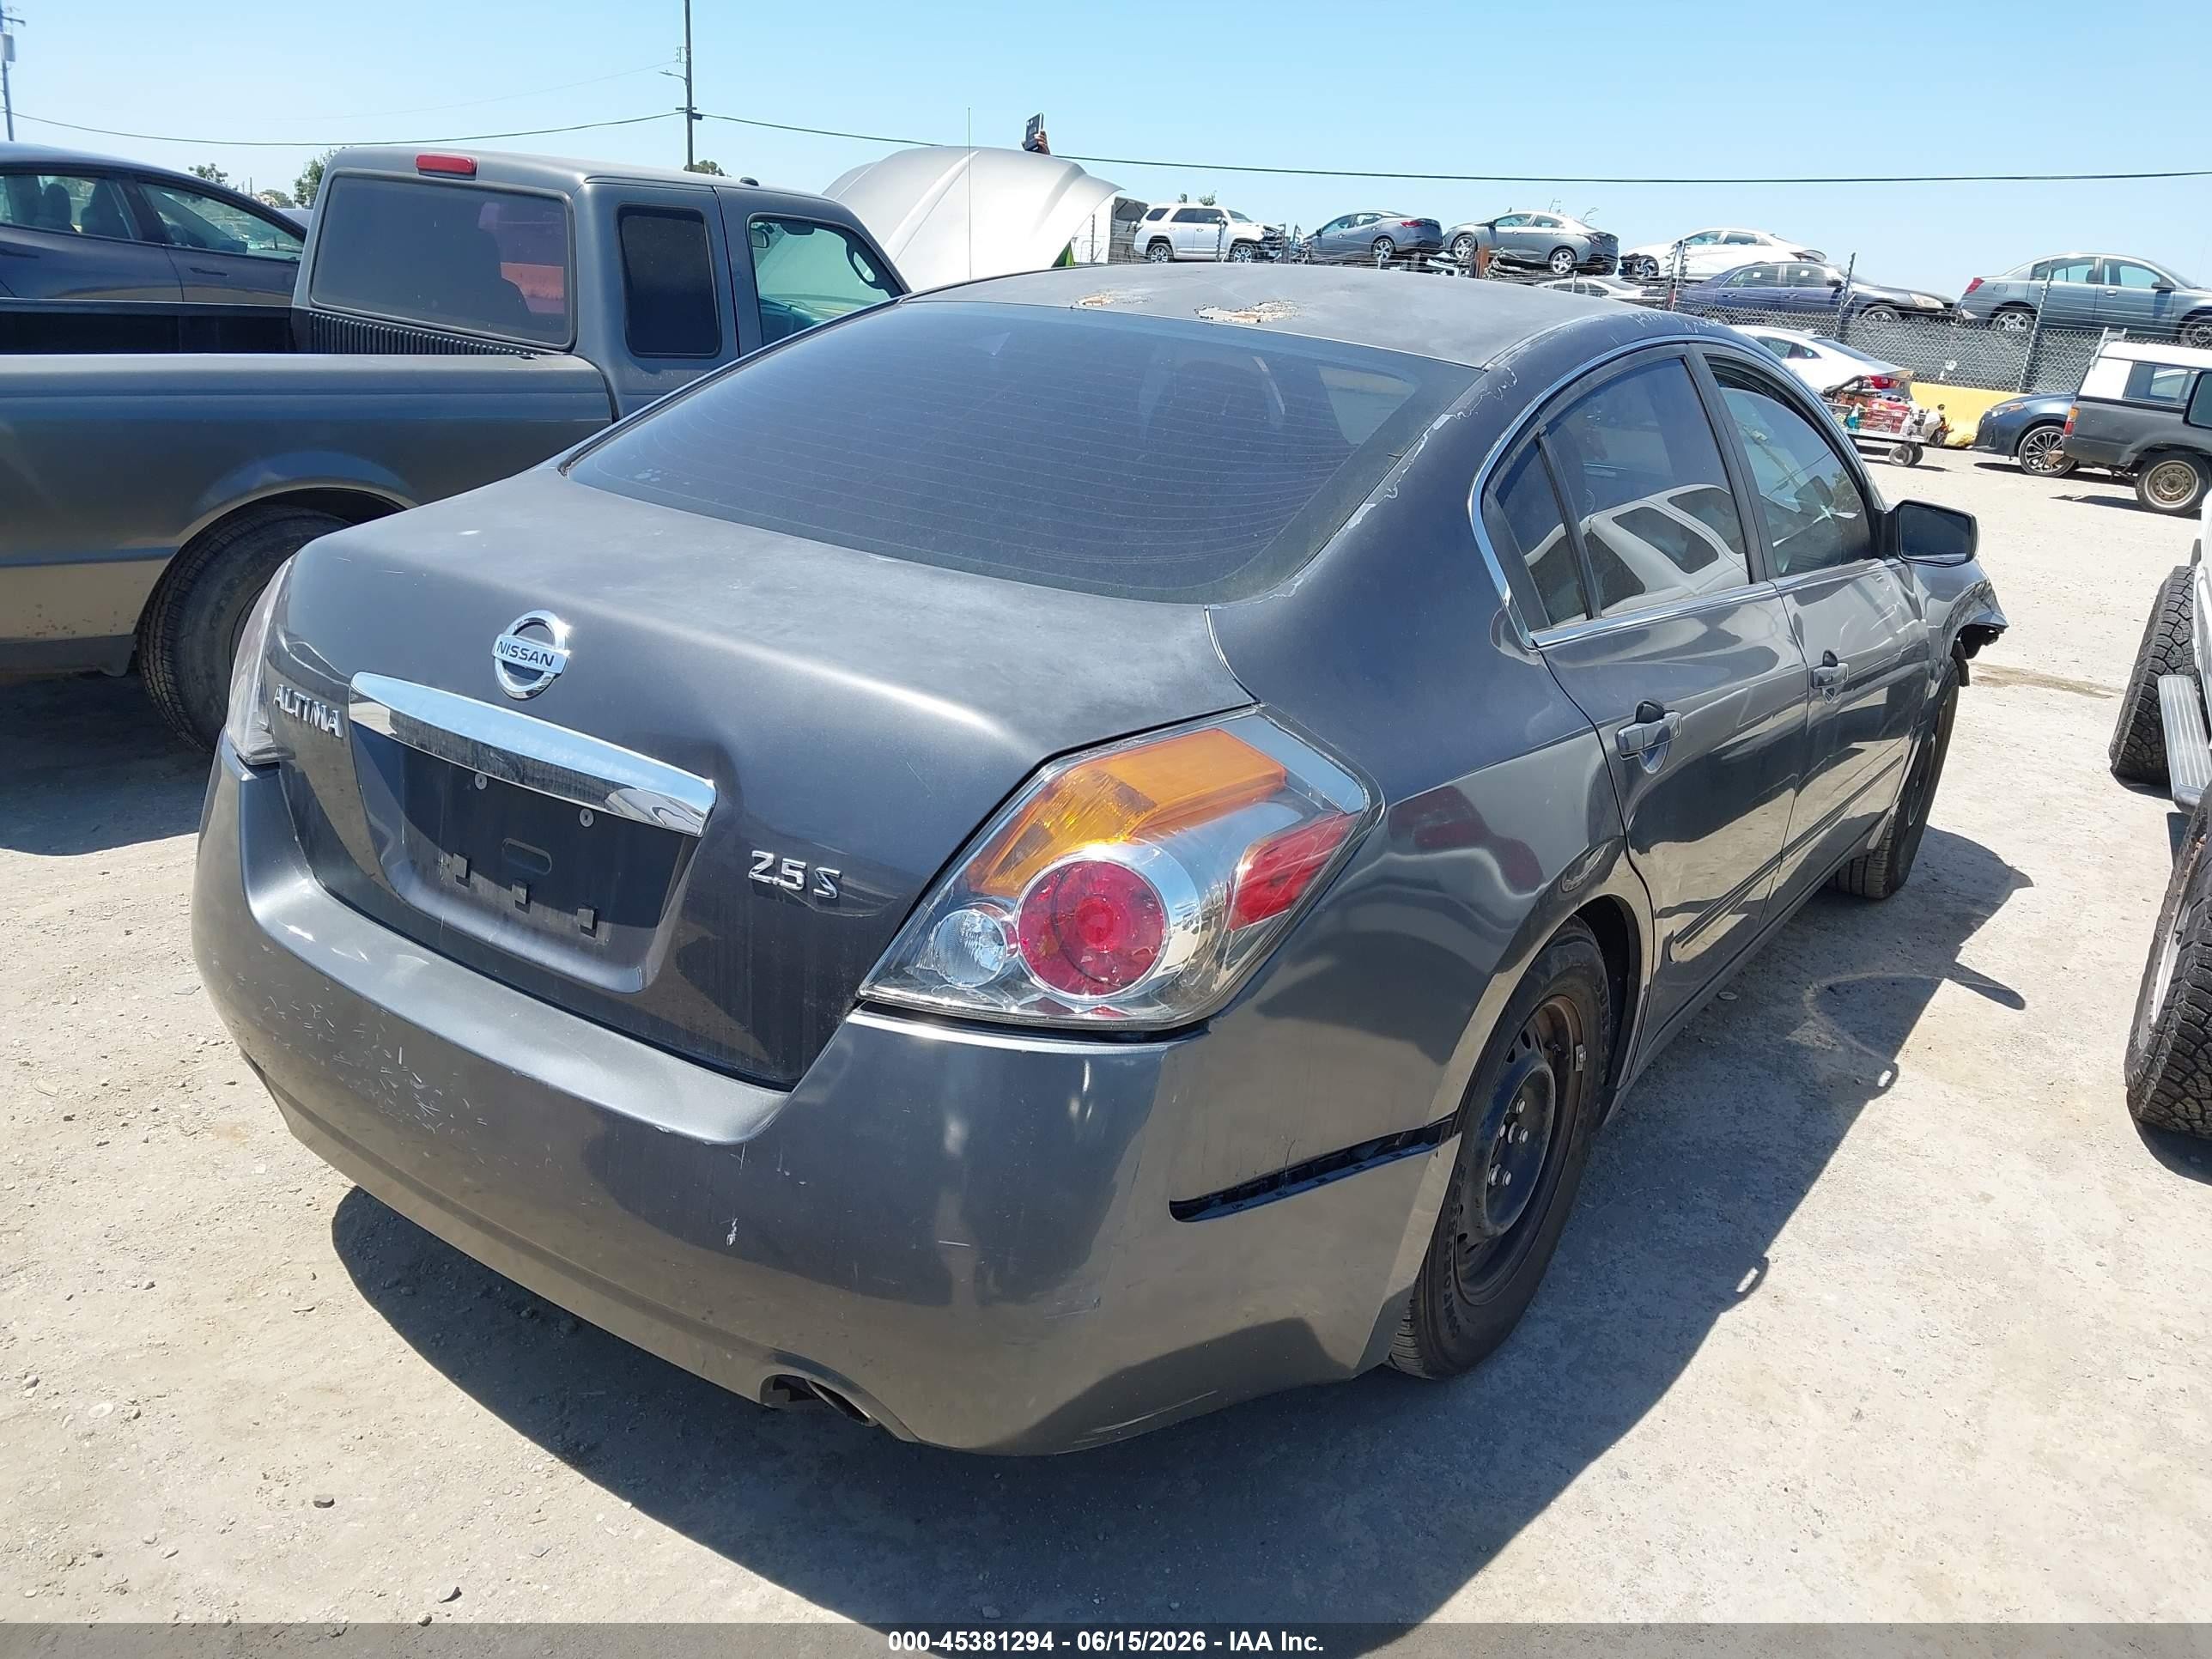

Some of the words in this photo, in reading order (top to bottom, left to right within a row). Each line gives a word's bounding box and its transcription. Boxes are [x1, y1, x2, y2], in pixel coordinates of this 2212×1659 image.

[497, 641, 555, 666] NISSAN
[273, 684, 343, 738] ALTIMA
[748, 850, 806, 891] 2.5
[813, 866, 842, 899] S
